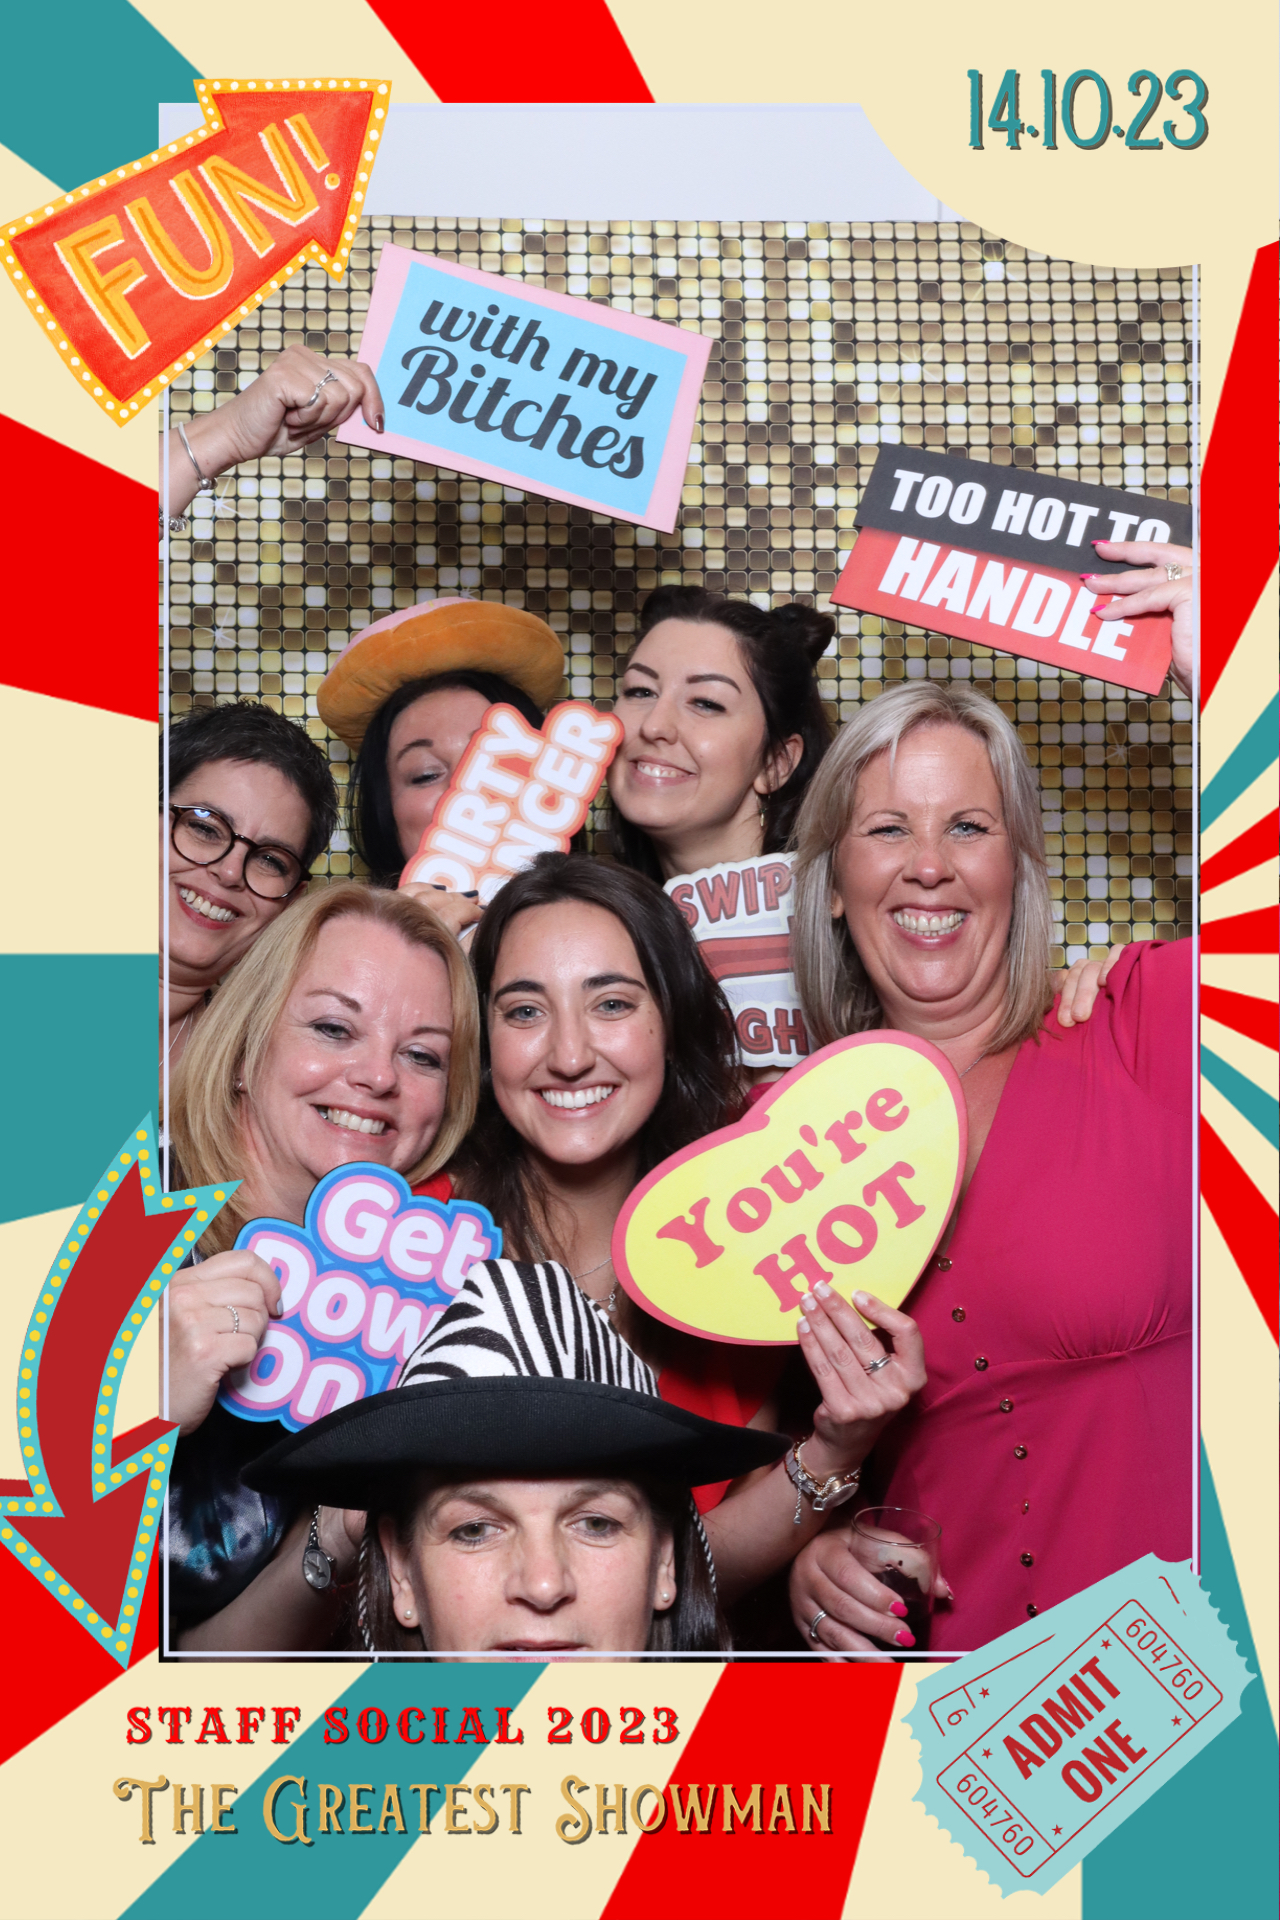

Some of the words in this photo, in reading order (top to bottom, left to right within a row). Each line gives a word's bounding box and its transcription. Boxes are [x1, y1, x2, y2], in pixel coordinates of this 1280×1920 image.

[397, 345, 645, 479] Bitches
[419, 299, 550, 372] with
[558, 347, 658, 420] my
[889, 469, 987, 525] TOO
[991, 489, 1099, 547] HOT
[477, 712, 612, 903] NCER
[670, 861, 794, 928] SWIP
[324, 1181, 486, 1290] Get
[656, 1087, 910, 1269] You're
[753, 1161, 926, 1313] HOT
[252, 1238, 446, 1361] Dow
[229, 1329, 361, 1418] On
